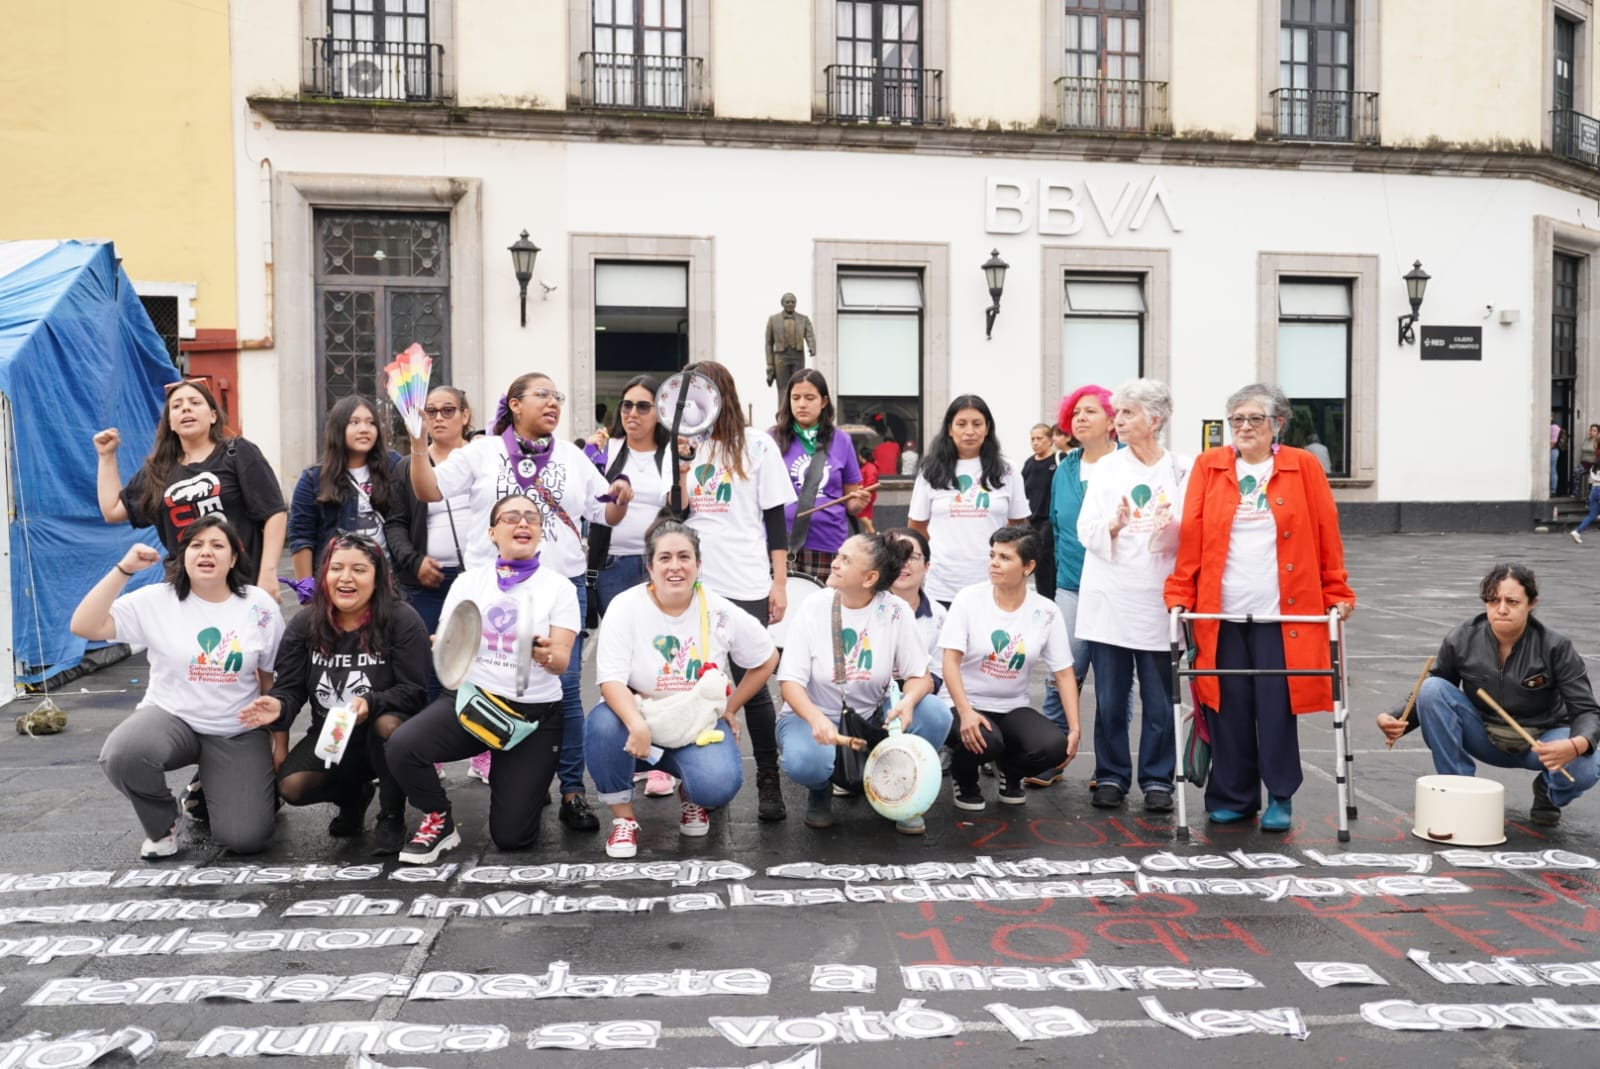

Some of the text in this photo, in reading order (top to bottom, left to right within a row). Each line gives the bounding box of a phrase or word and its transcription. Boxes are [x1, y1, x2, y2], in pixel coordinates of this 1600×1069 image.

[985, 175, 1183, 237] BBVA
[281, 894, 403, 916] sin
[728, 884, 847, 906] las
[846, 876, 1136, 902] adultas
[1137, 872, 1473, 901] mayores
[389, 863, 458, 882] el
[811, 965, 876, 991] a
[901, 960, 1264, 991] madres
[1296, 962, 1388, 988] e
[187, 1022, 509, 1056] nunca
[527, 1020, 660, 1049] se
[984, 1003, 1098, 1040] la
[1138, 996, 1310, 1040] Ley
